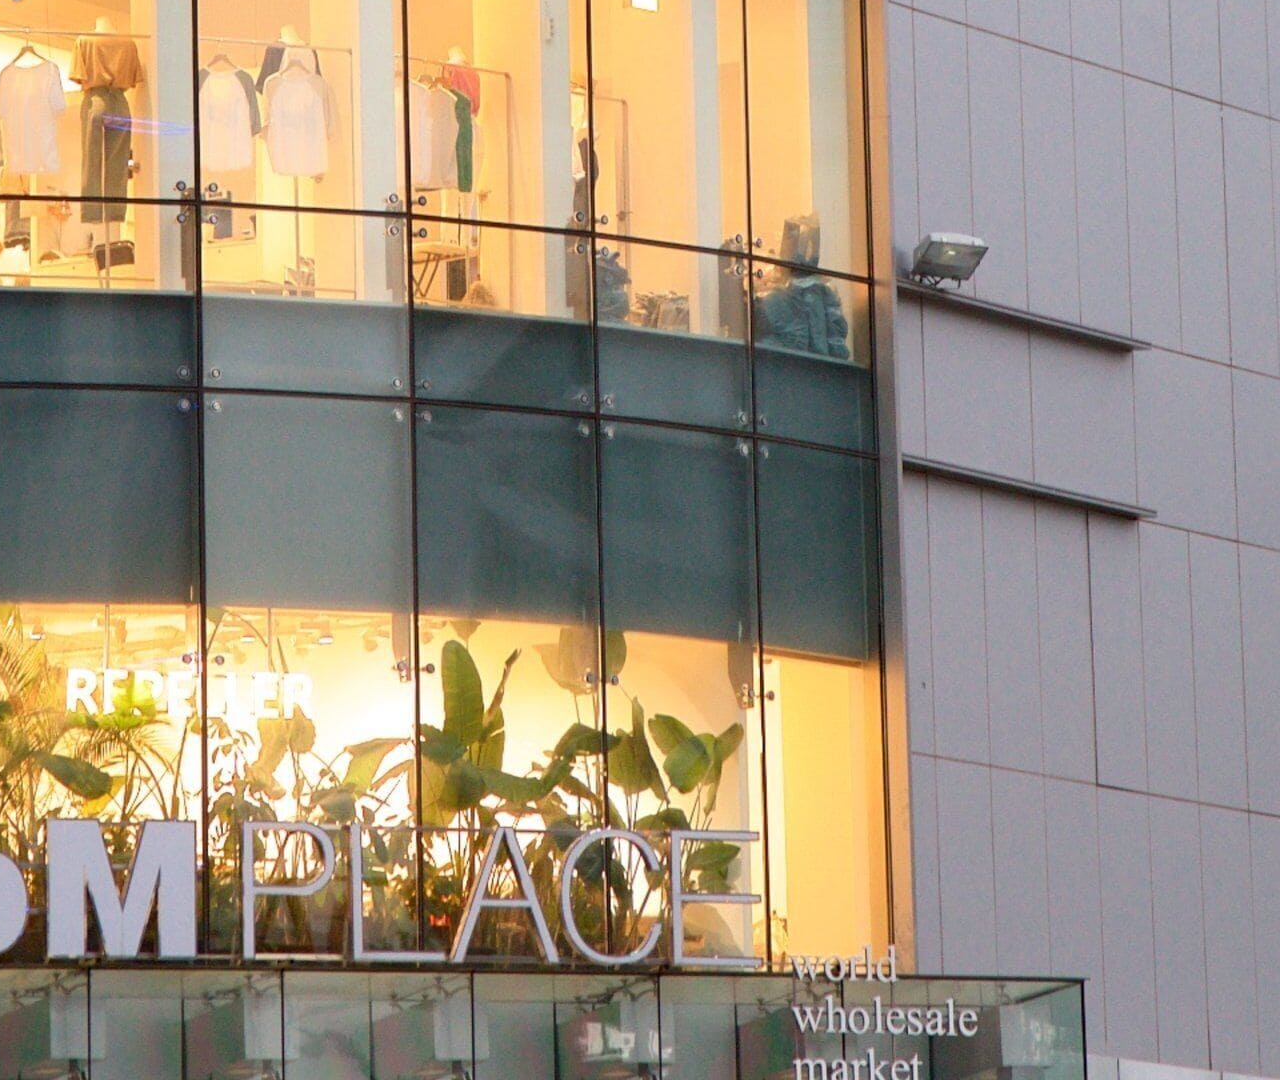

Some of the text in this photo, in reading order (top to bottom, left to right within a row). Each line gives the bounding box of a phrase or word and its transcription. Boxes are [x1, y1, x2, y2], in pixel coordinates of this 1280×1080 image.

[241, 819, 763, 968] PLACE
[789, 944, 898, 984] world
[791, 994, 979, 1038] wholesale
[793, 1048, 924, 1080] market
